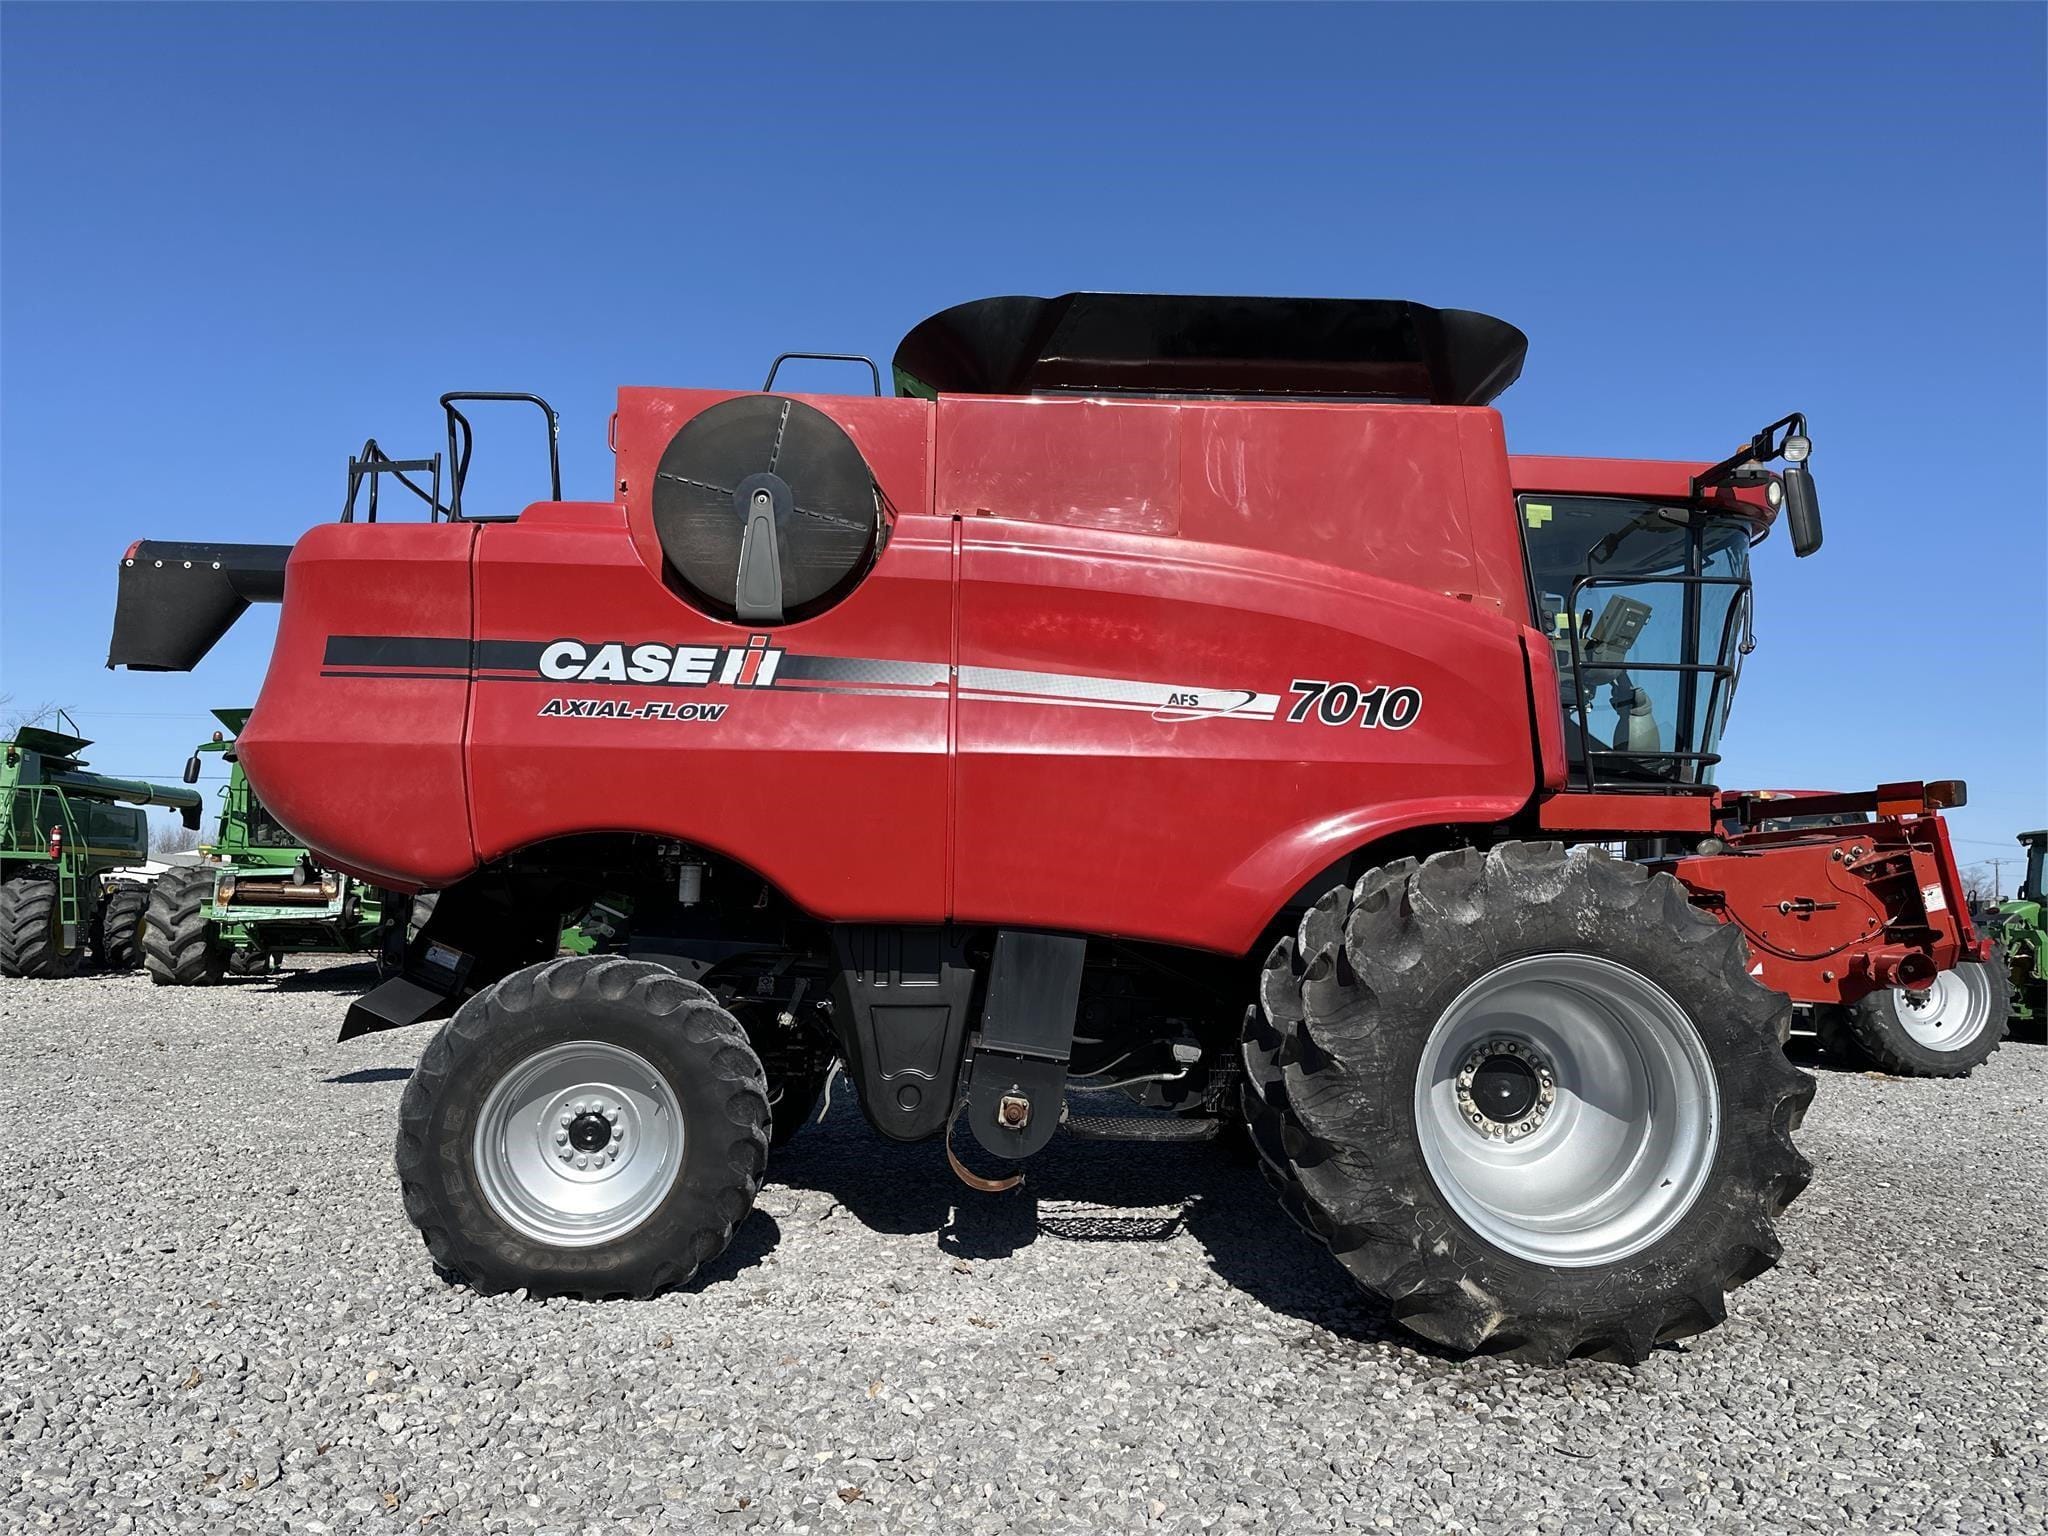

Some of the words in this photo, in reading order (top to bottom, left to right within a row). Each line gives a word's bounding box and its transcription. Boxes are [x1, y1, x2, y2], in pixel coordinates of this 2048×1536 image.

[540, 641, 718, 683] CASE
[539, 700, 728, 721] AXIAL-FLOW
[1168, 693, 1199, 706] AFS
[1286, 679, 1422, 730] 7010
